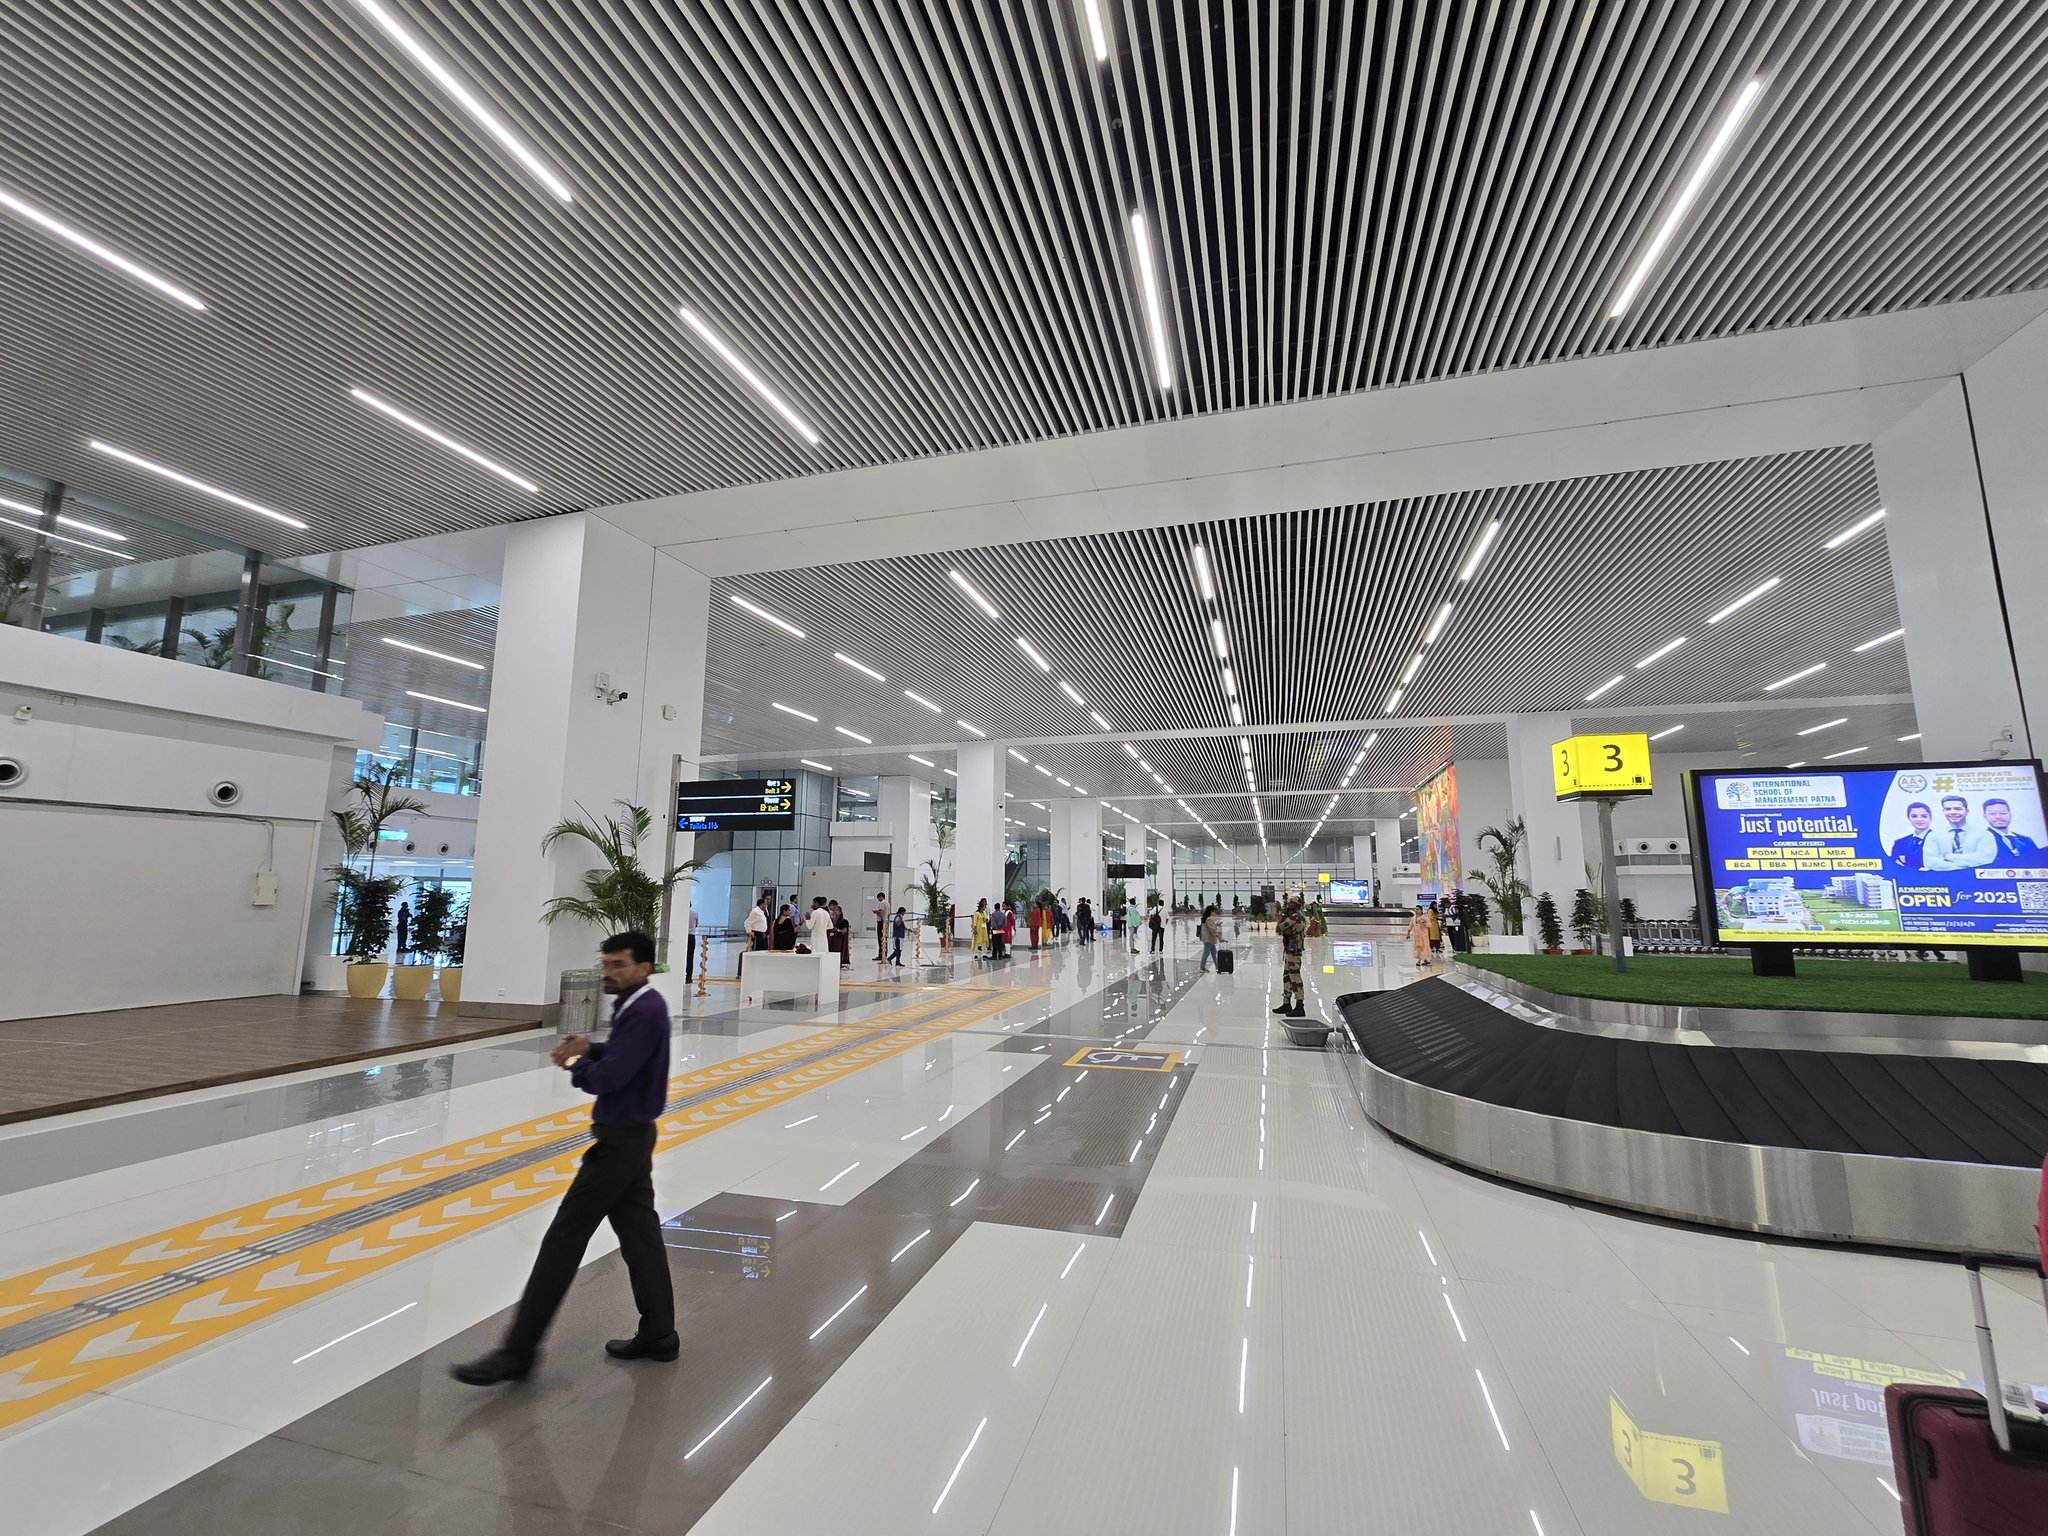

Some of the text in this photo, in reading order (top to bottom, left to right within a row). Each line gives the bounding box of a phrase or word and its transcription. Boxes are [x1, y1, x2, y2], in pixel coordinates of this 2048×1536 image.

[1561, 749, 1570, 777] 3
[1602, 744, 1624, 772] 3
[1739, 815, 1859, 836] Just potential.
[1837, 861, 1878, 869] B.Com(P)
[1899, 894, 1951, 907] OPEN
[1953, 891, 2018, 903] for 2025
